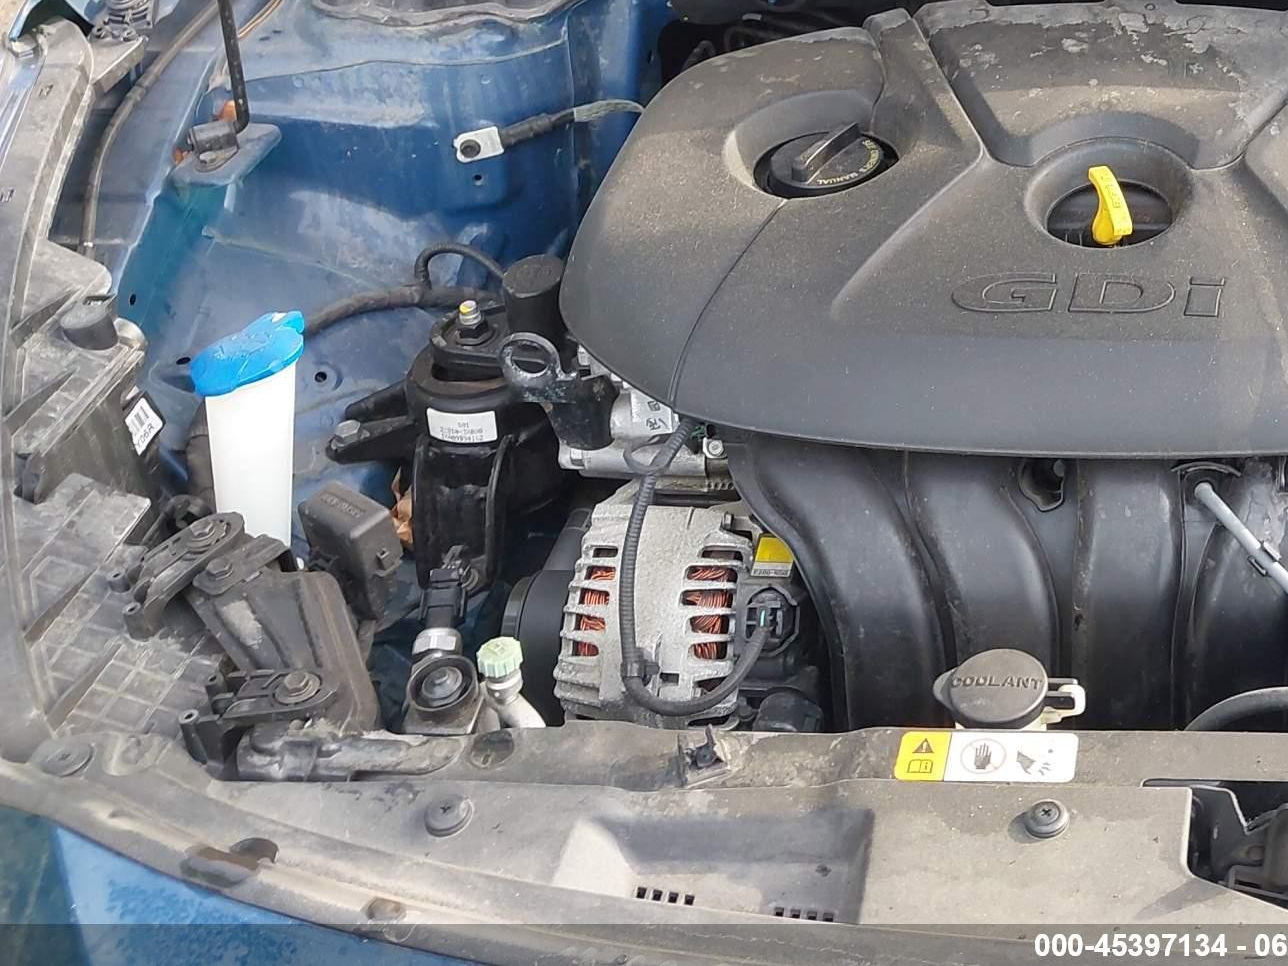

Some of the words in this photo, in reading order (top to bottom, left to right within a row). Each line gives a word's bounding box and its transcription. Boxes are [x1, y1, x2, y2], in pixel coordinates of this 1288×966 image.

[816, 172, 859, 185] MANUAL
[951, 271, 1229, 318] GDi
[951, 675, 1043, 691] COOLANT
